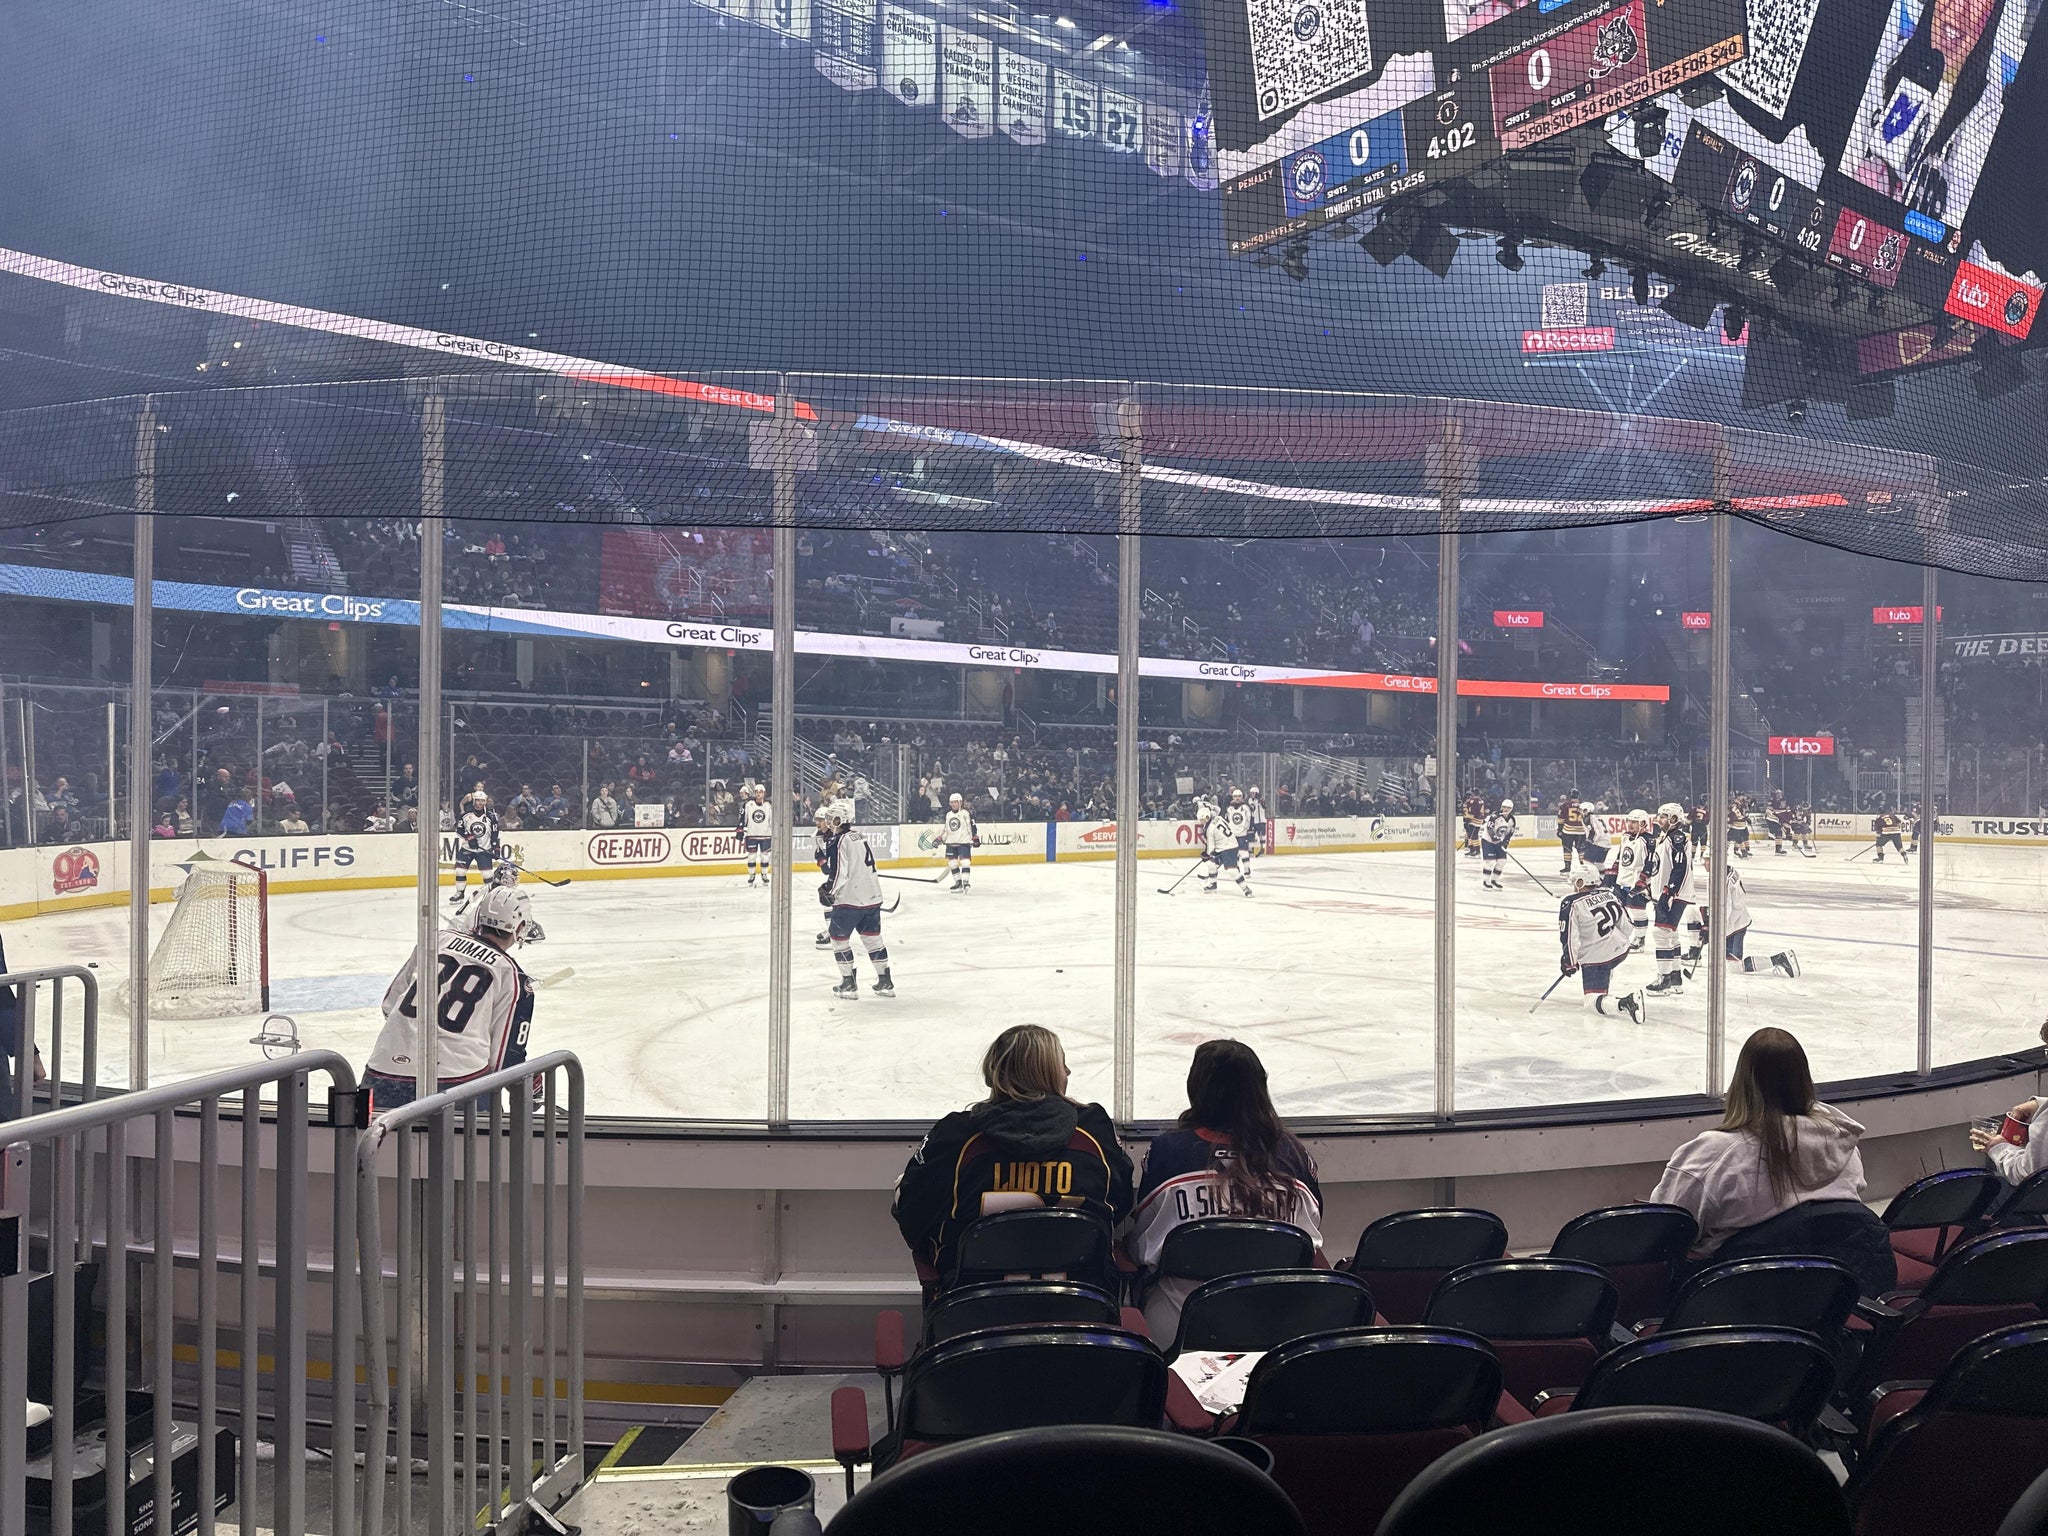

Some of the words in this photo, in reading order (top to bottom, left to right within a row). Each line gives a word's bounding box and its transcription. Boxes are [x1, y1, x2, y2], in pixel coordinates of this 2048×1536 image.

[886, 19, 933, 45] CHAMPIONS
[1563, 16, 1582, 33] game
[956, 37, 978, 53] 2016
[943, 47, 973, 66] CALDER
[975, 58, 991, 72] CUP
[1005, 57, 1040, 79] 2015-16
[1528, 49, 1551, 90] 0
[944, 62, 990, 87] CHAMPIONS
[1006, 73, 1039, 93] WESTERN
[1001, 83, 1044, 106] CONFERENCE
[1519, 131, 1525, 143] 5
[1529, 123, 1551, 140] FOR
[1553, 112, 1573, 130] $10
[1581, 103, 1597, 118] 50
[1599, 92, 1622, 109] FOR
[1625, 81, 1649, 100] $20
[1658, 68, 1679, 86] 125
[1683, 55, 1707, 75] FOR
[1711, 41, 1738, 65] $40
[1550, 91, 1577, 108] SAVES
[1002, 96, 1042, 119] CHAMPIONS
[1062, 92, 1091, 132] 15
[1505, 110, 1531, 128] SHOTS
[1107, 109, 1137, 150] 27
[1426, 121, 1476, 159] 4:02
[1349, 129, 1370, 166] 0
[1238, 168, 1274, 192] PENALTY
[1364, 169, 1386, 185] SAVES
[1325, 192, 1361, 219] TONIGHT'S
[1362, 187, 1386, 206] TOTAL
[1389, 170, 1426, 195] $1,256
[1769, 176, 1786, 212] 0
[1796, 226, 1822, 252] 4:02
[1849, 219, 1866, 251] 0
[100, 273, 156, 298] Great
[160, 284, 207, 307] Clips
[1957, 278, 1990, 309] fubo
[436, 334, 481, 355] Great
[485, 342, 521, 362] Clips
[1545, 331, 1609, 350] Rocket
[701, 384, 742, 404] Great
[887, 419, 923, 438] Great
[925, 426, 954, 444] Clips
[236, 588, 314, 613] Great
[320, 595, 383, 621] Clips
[1889, 609, 1911, 621] fubo
[1507, 613, 1530, 624] fubo
[1686, 614, 1707, 626] fubo
[666, 623, 717, 642] Great
[720, 627, 760, 648] Clips
[969, 646, 1007, 662] Great
[1009, 649, 1039, 666] Clips
[1954, 640, 1995, 658] THE
[1199, 663, 1229, 677] Great
[1231, 664, 1256, 680] Clips
[1384, 675, 1410, 688] Great
[1412, 676, 1433, 691] Clips
[1542, 684, 1577, 696] Great
[1579, 684, 1611, 699] Clips
[1780, 738, 1822, 754] fubo
[233, 846, 355, 870] CLIFFS
[863, 841, 877, 872] 4
[1674, 852, 1684, 864] 41
[1590, 901, 1623, 937] 20
[446, 937, 501, 966] DUMAIS
[1214, 1150, 1239, 1158] CC
[993, 1162, 1072, 1194] LUOTO
